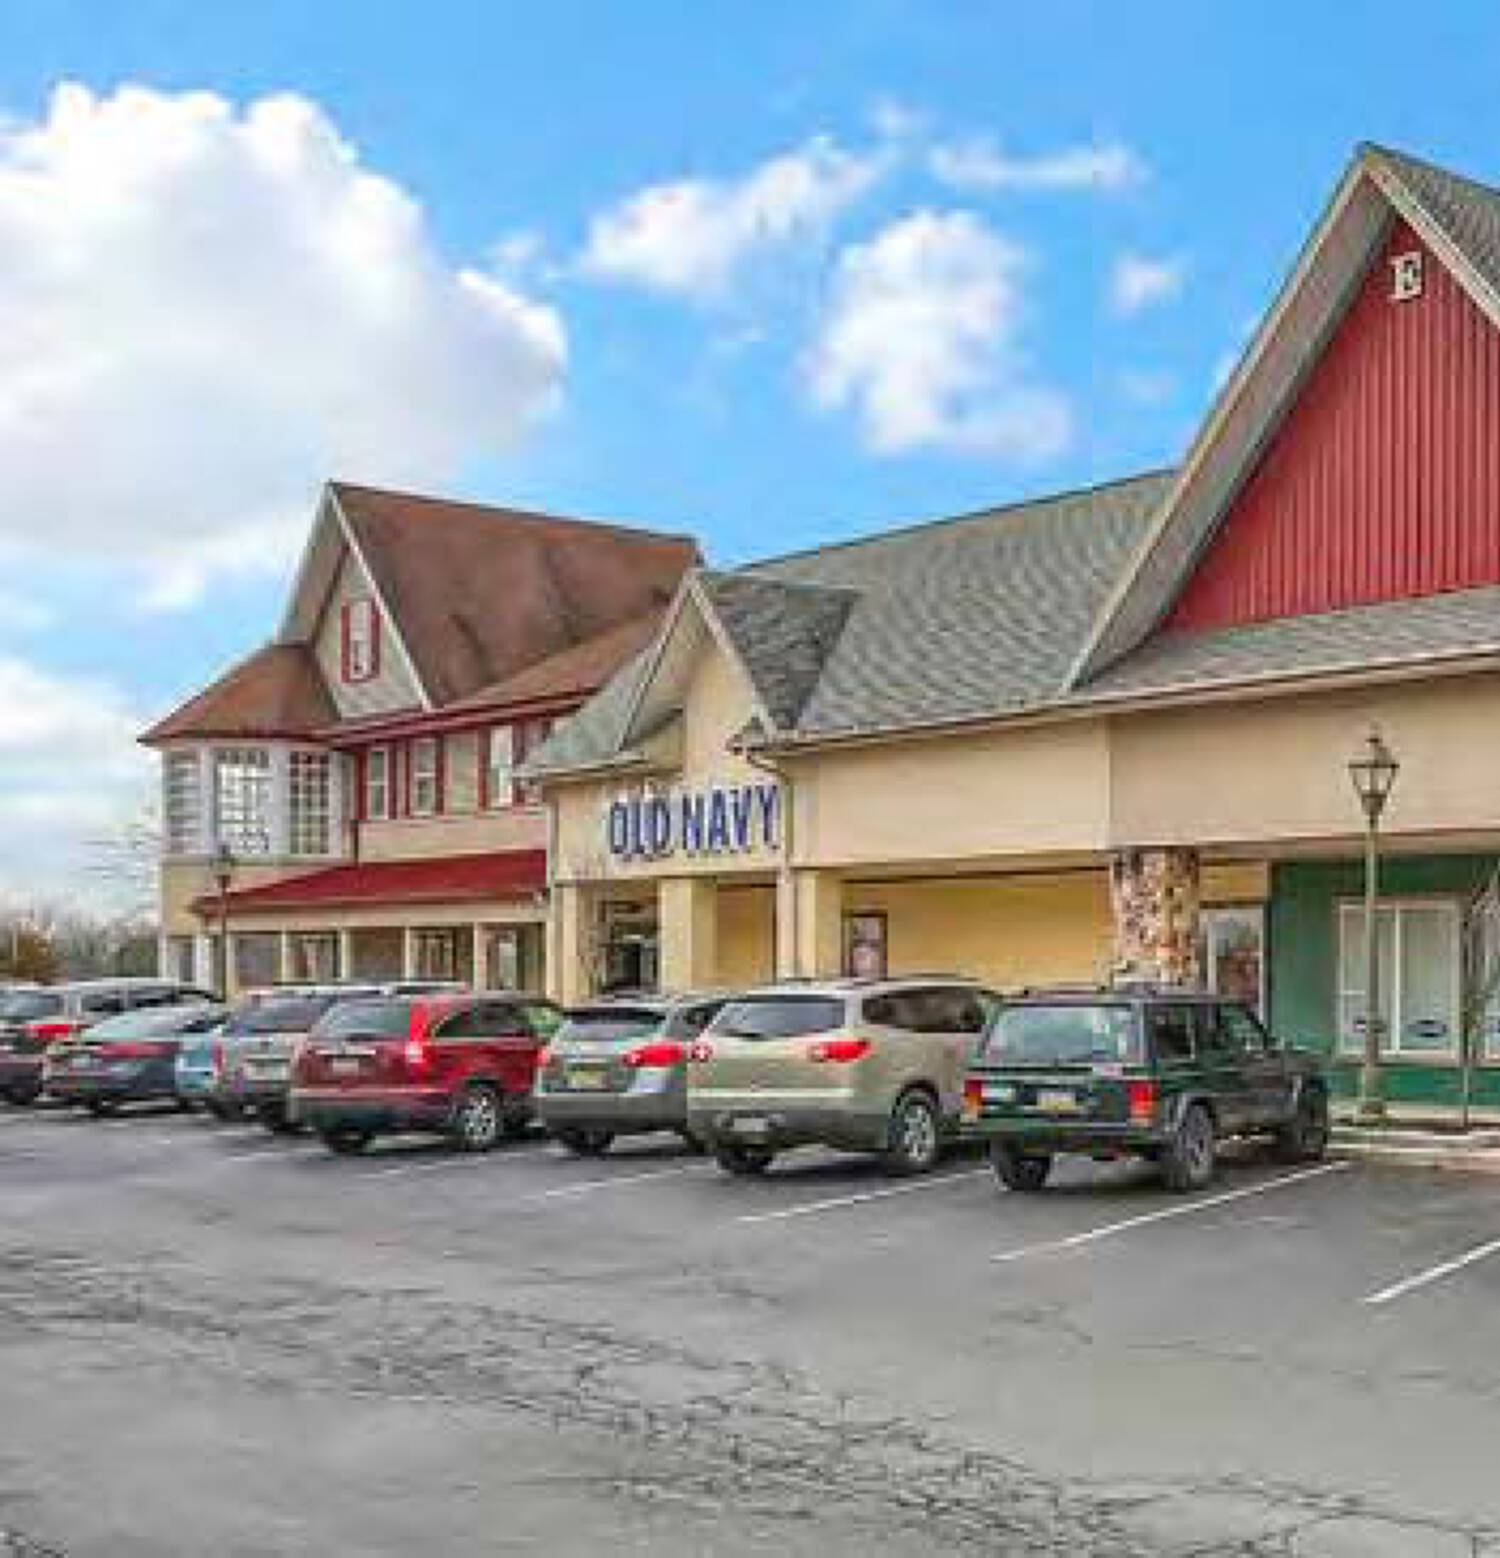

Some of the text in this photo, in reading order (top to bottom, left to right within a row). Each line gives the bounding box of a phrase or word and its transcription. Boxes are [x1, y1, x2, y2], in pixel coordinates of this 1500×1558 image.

[1387, 252, 1422, 300] E
[609, 783, 779, 857] OLD NAVY
